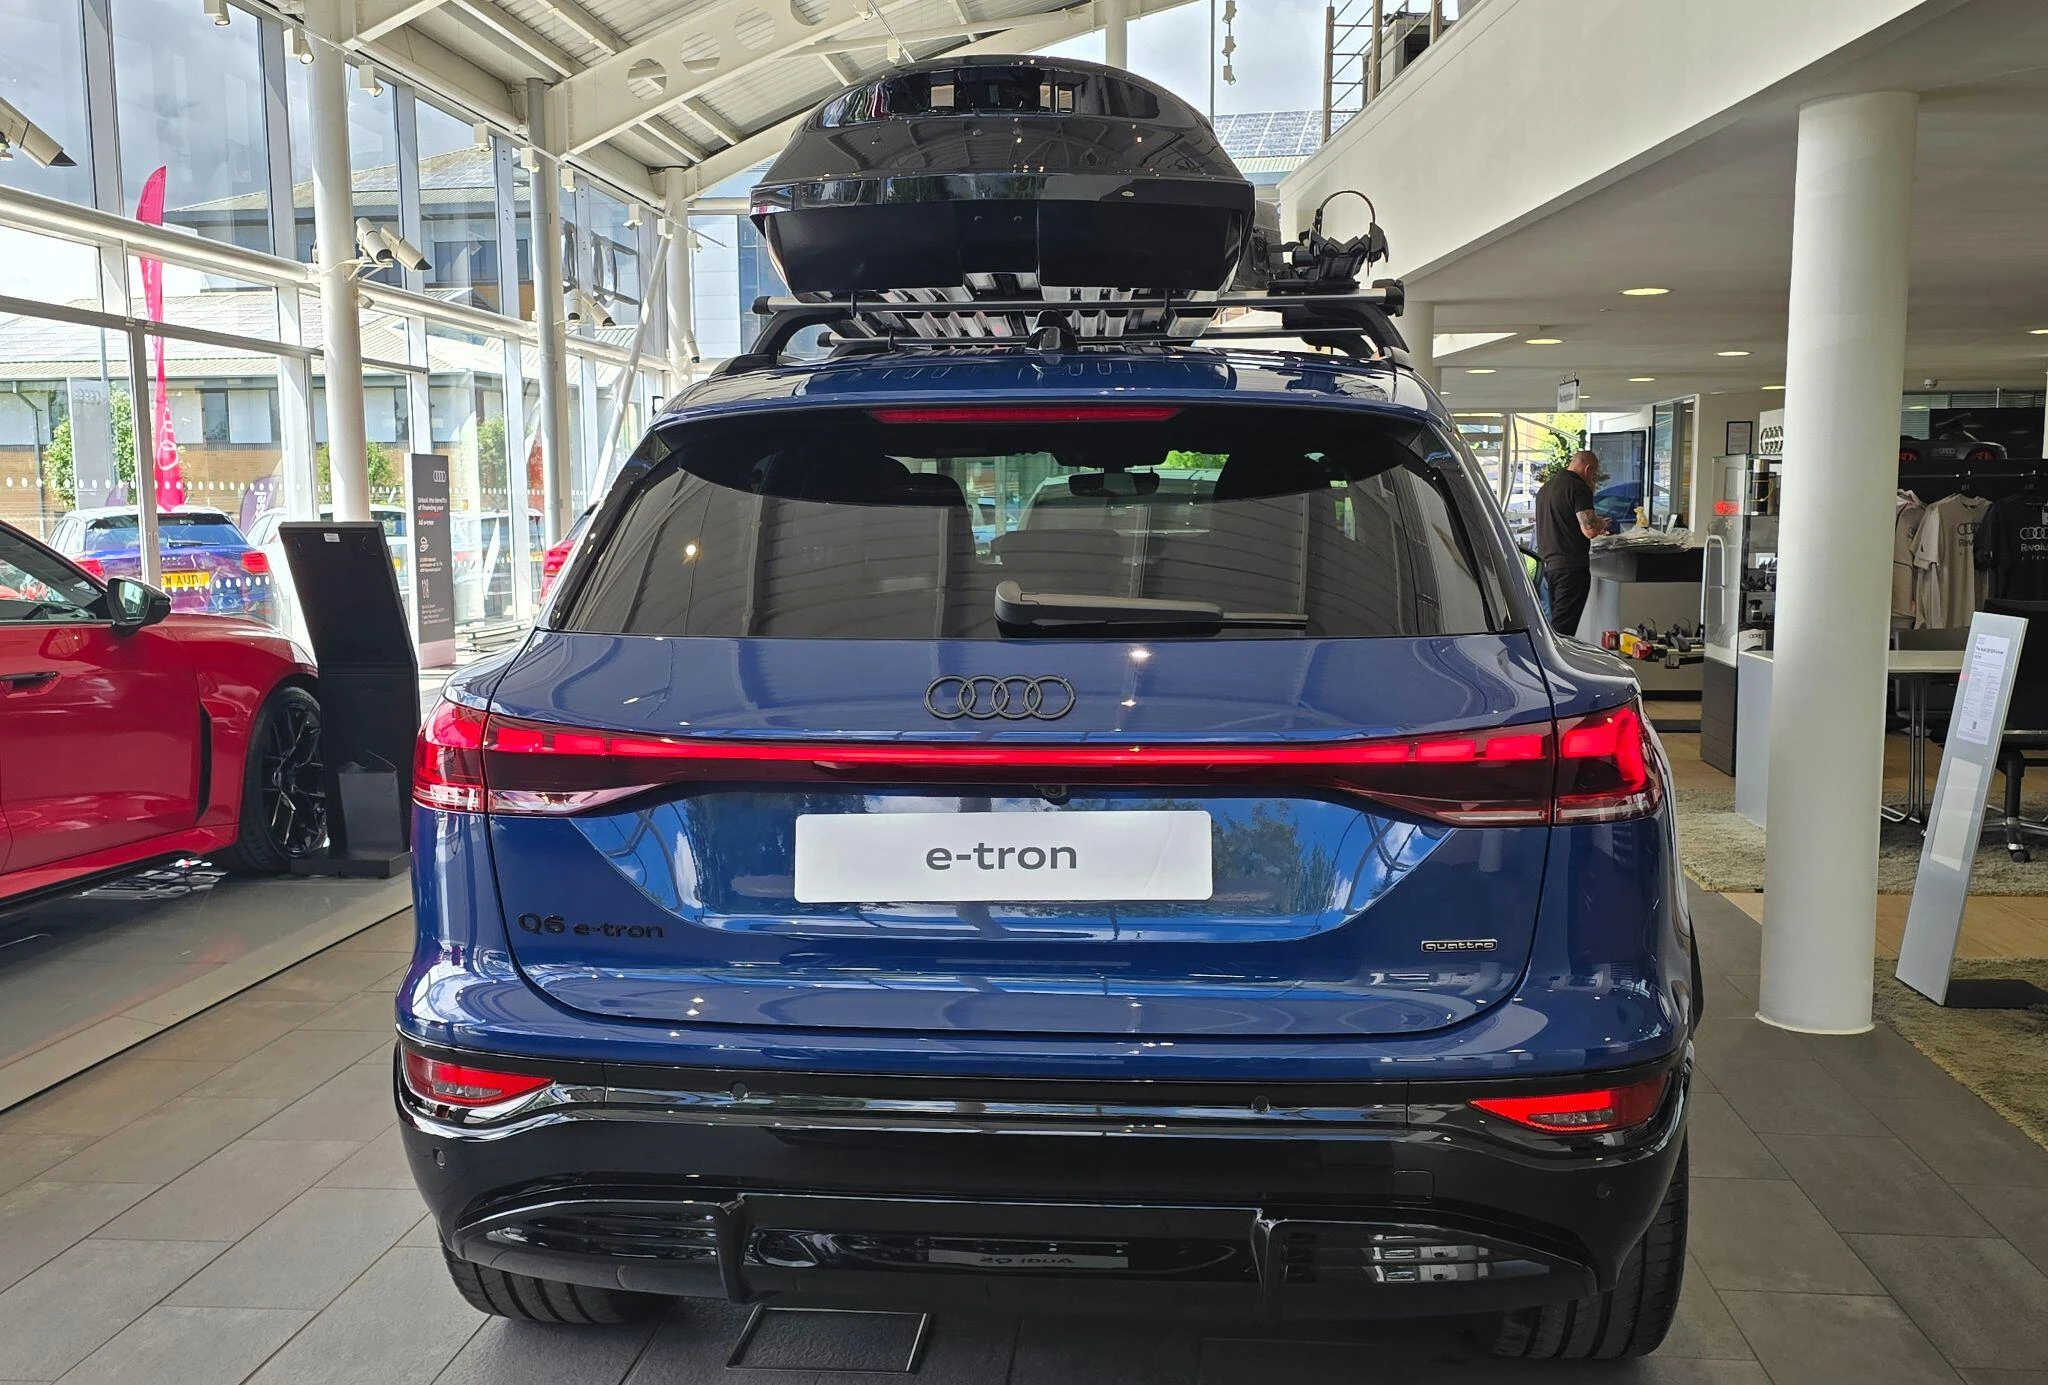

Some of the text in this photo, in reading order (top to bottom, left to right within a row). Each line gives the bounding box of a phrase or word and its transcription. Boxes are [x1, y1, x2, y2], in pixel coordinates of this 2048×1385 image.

[925, 842, 1077, 871] e-tron
[518, 911, 665, 939] Q6 e-tron
[1424, 941, 1495, 952] quattro
